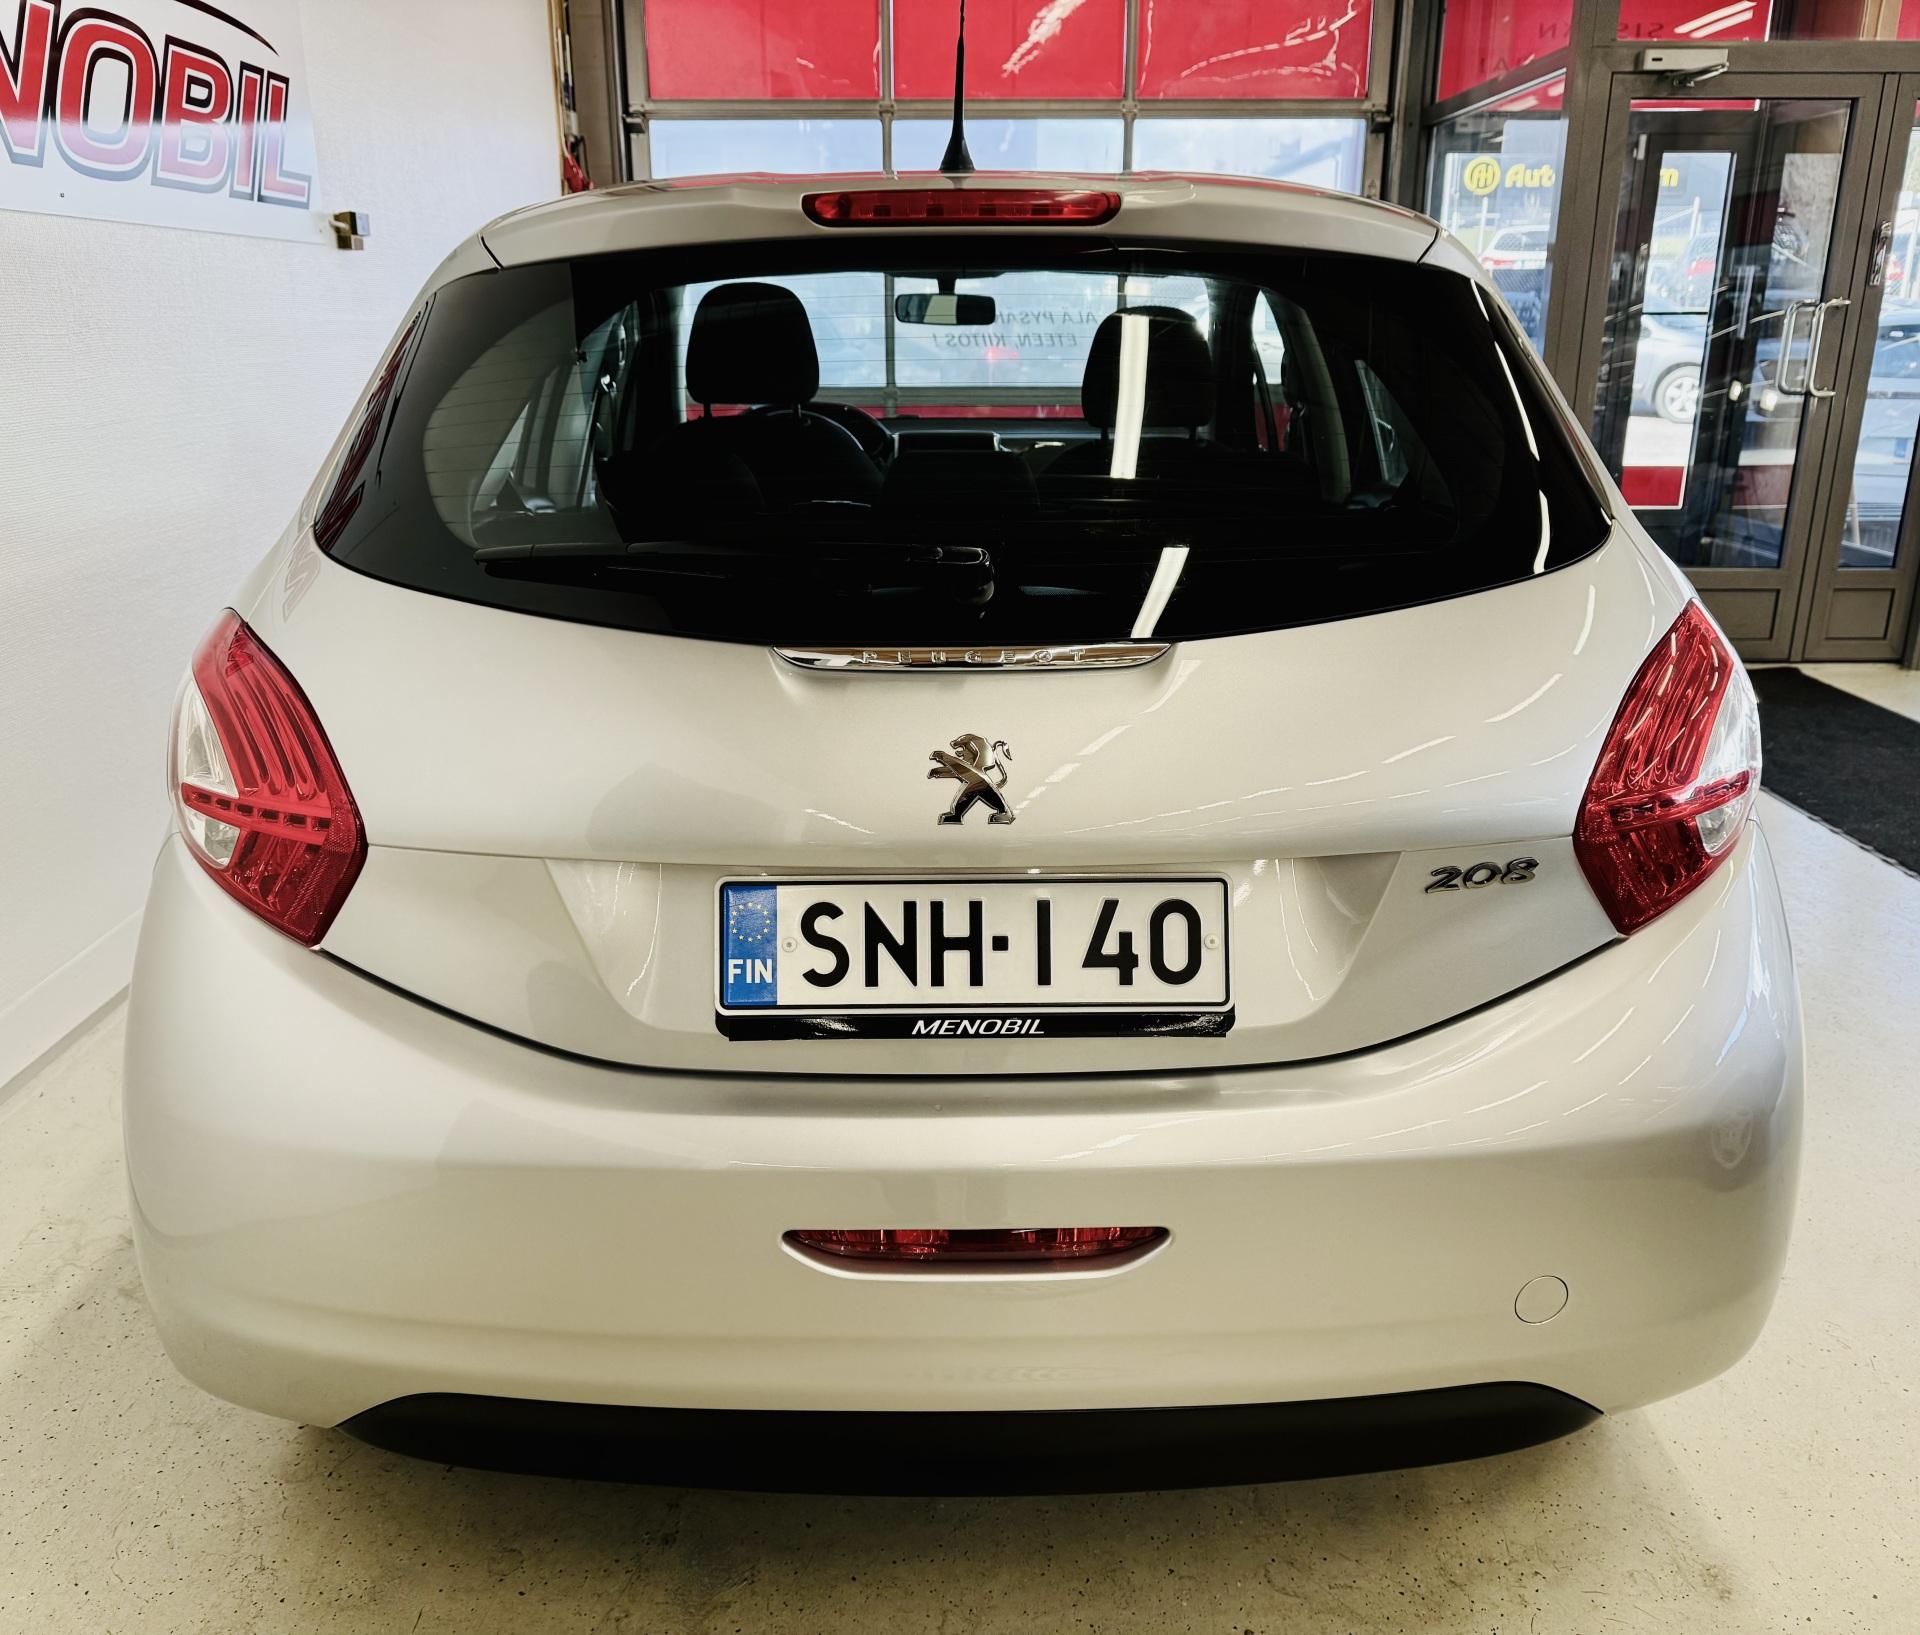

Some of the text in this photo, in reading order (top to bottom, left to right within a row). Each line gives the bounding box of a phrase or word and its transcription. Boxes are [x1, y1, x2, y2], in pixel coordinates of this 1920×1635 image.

[862, 649, 1085, 664] PEUGEOT
[1424, 856, 1540, 893] 208
[800, 898, 1200, 988] SNH-140
[727, 959, 773, 984] FIN
[911, 1019, 1046, 1036] MENOBIL
